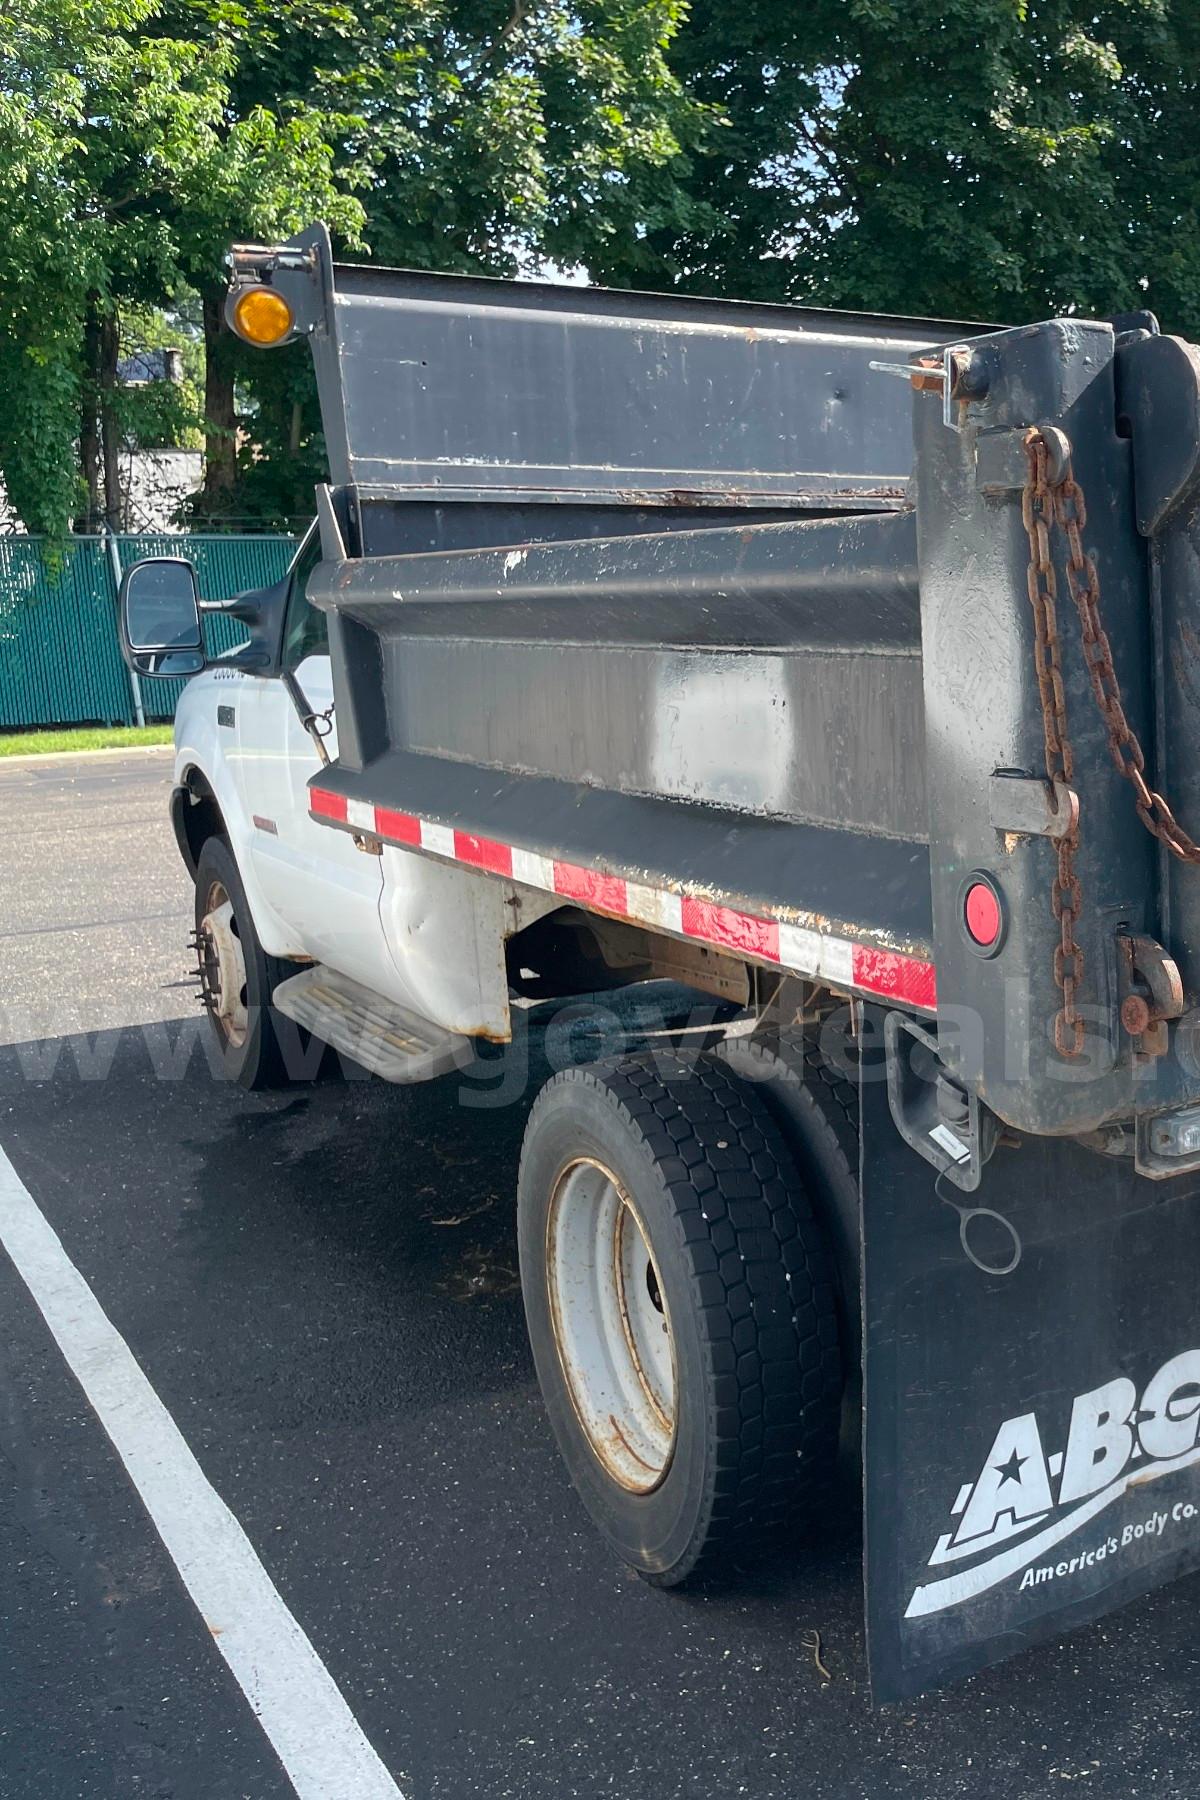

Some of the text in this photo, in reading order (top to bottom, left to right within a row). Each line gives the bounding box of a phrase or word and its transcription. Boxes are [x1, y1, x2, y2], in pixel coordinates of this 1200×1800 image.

[1019, 1502, 1200, 1591] America's Body Co.
